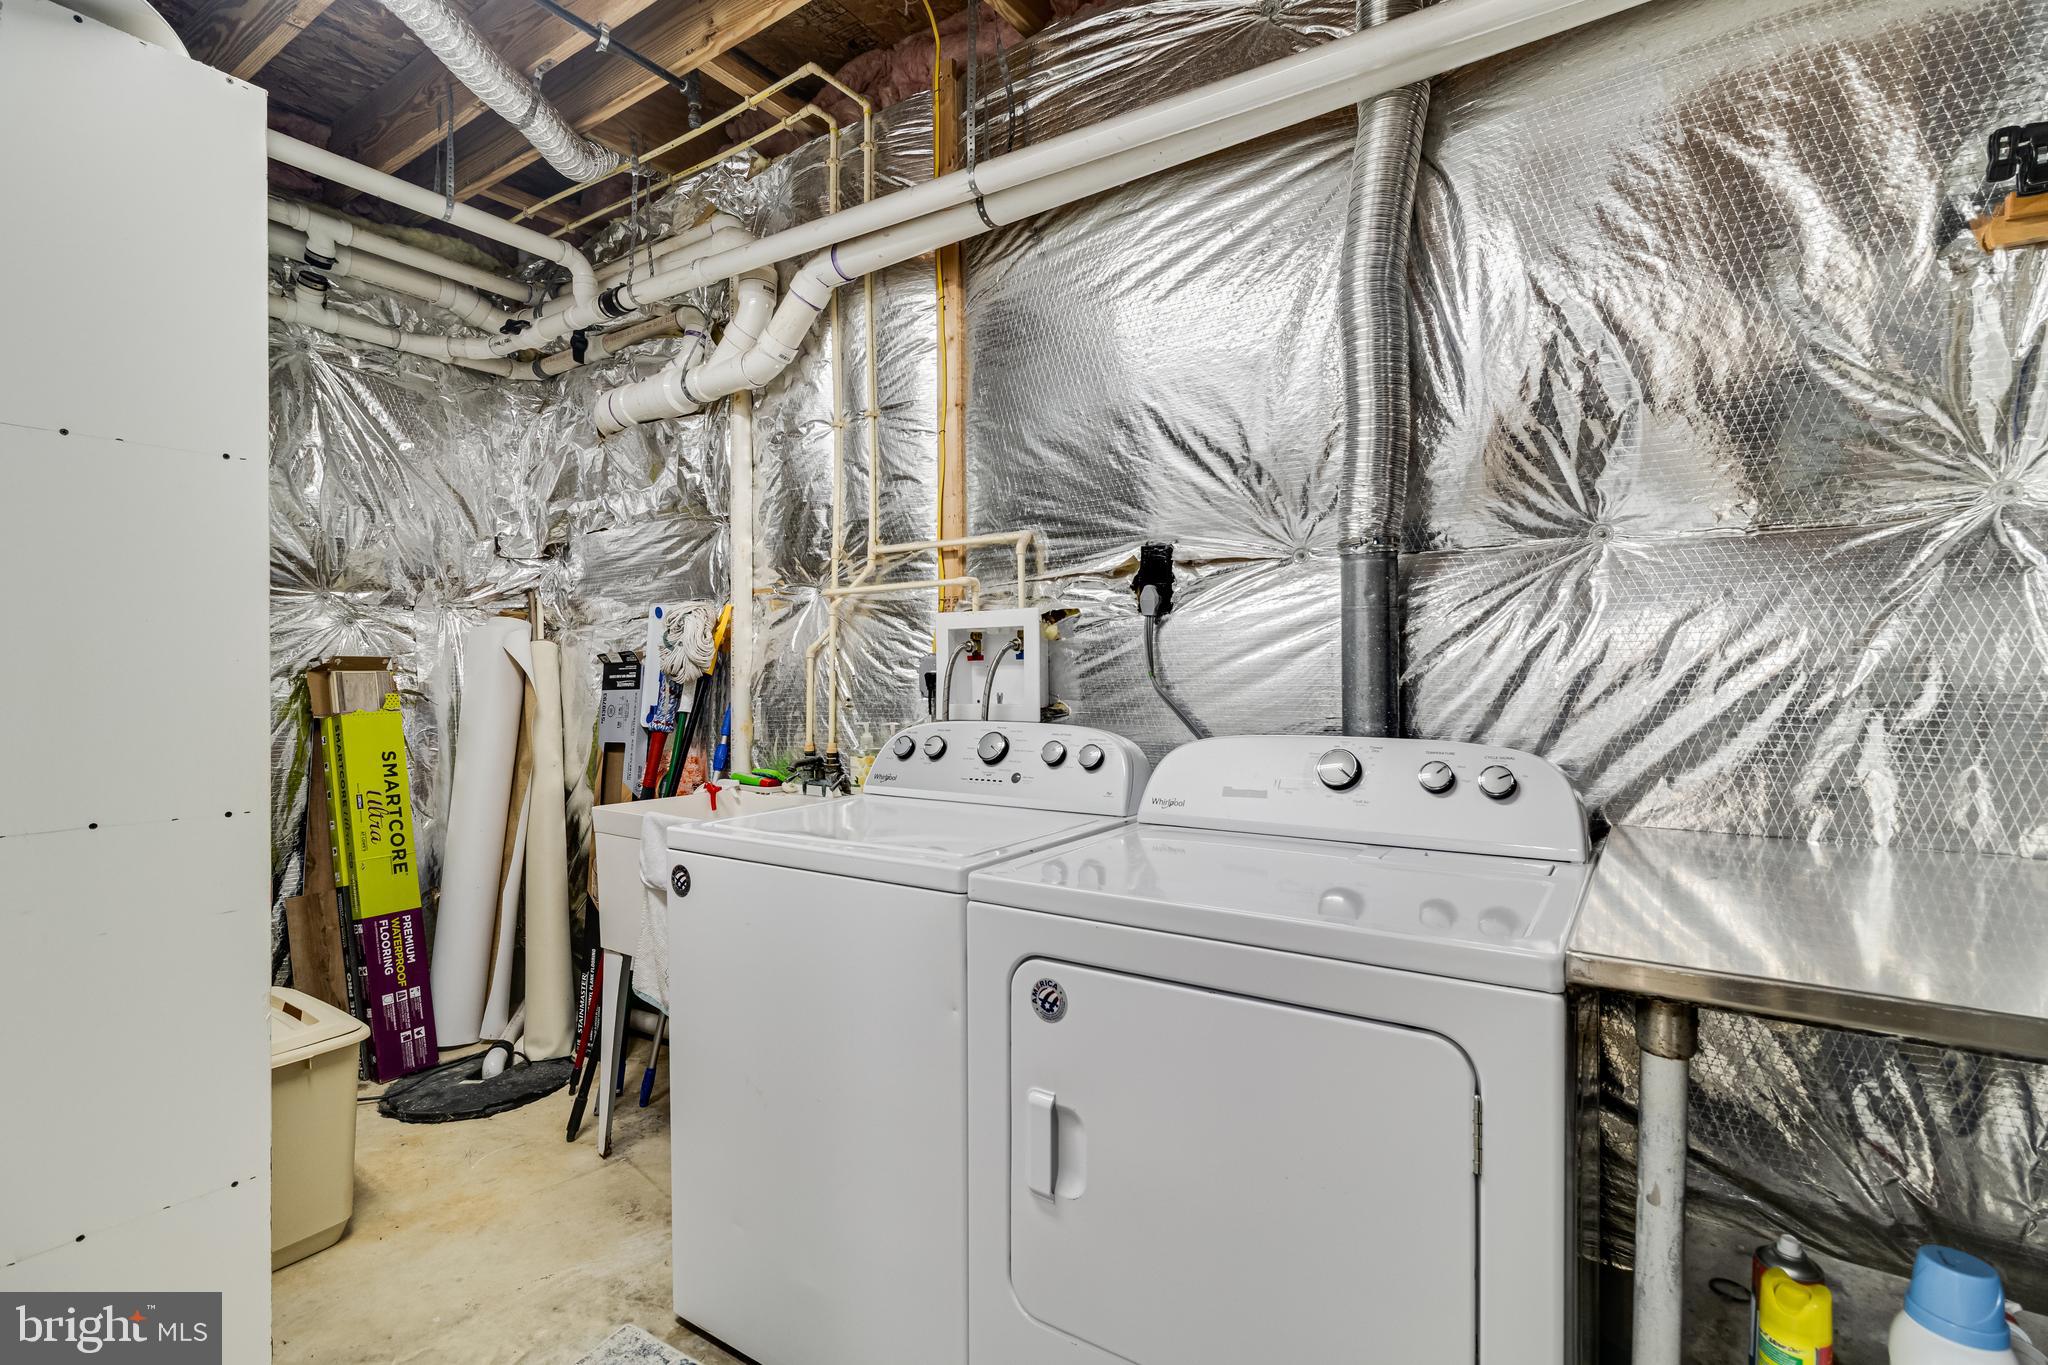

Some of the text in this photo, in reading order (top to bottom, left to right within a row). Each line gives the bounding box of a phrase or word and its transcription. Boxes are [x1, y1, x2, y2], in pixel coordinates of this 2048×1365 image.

[335, 725, 347, 807] SMARTCORE
[874, 773, 897, 783] Whirlpool
[366, 790, 390, 845] Ultra
[382, 751, 408, 875] SMARTCORE
[1152, 797, 1185, 809] Whirlpool
[379, 919, 394, 976] FLOORING
[391, 917, 407, 987] WATERPROOF
[402, 915, 416, 963] PREMIUM
[578, 972, 588, 1034] STAINMASTER
[1032, 980, 1058, 1004] AMERICA
